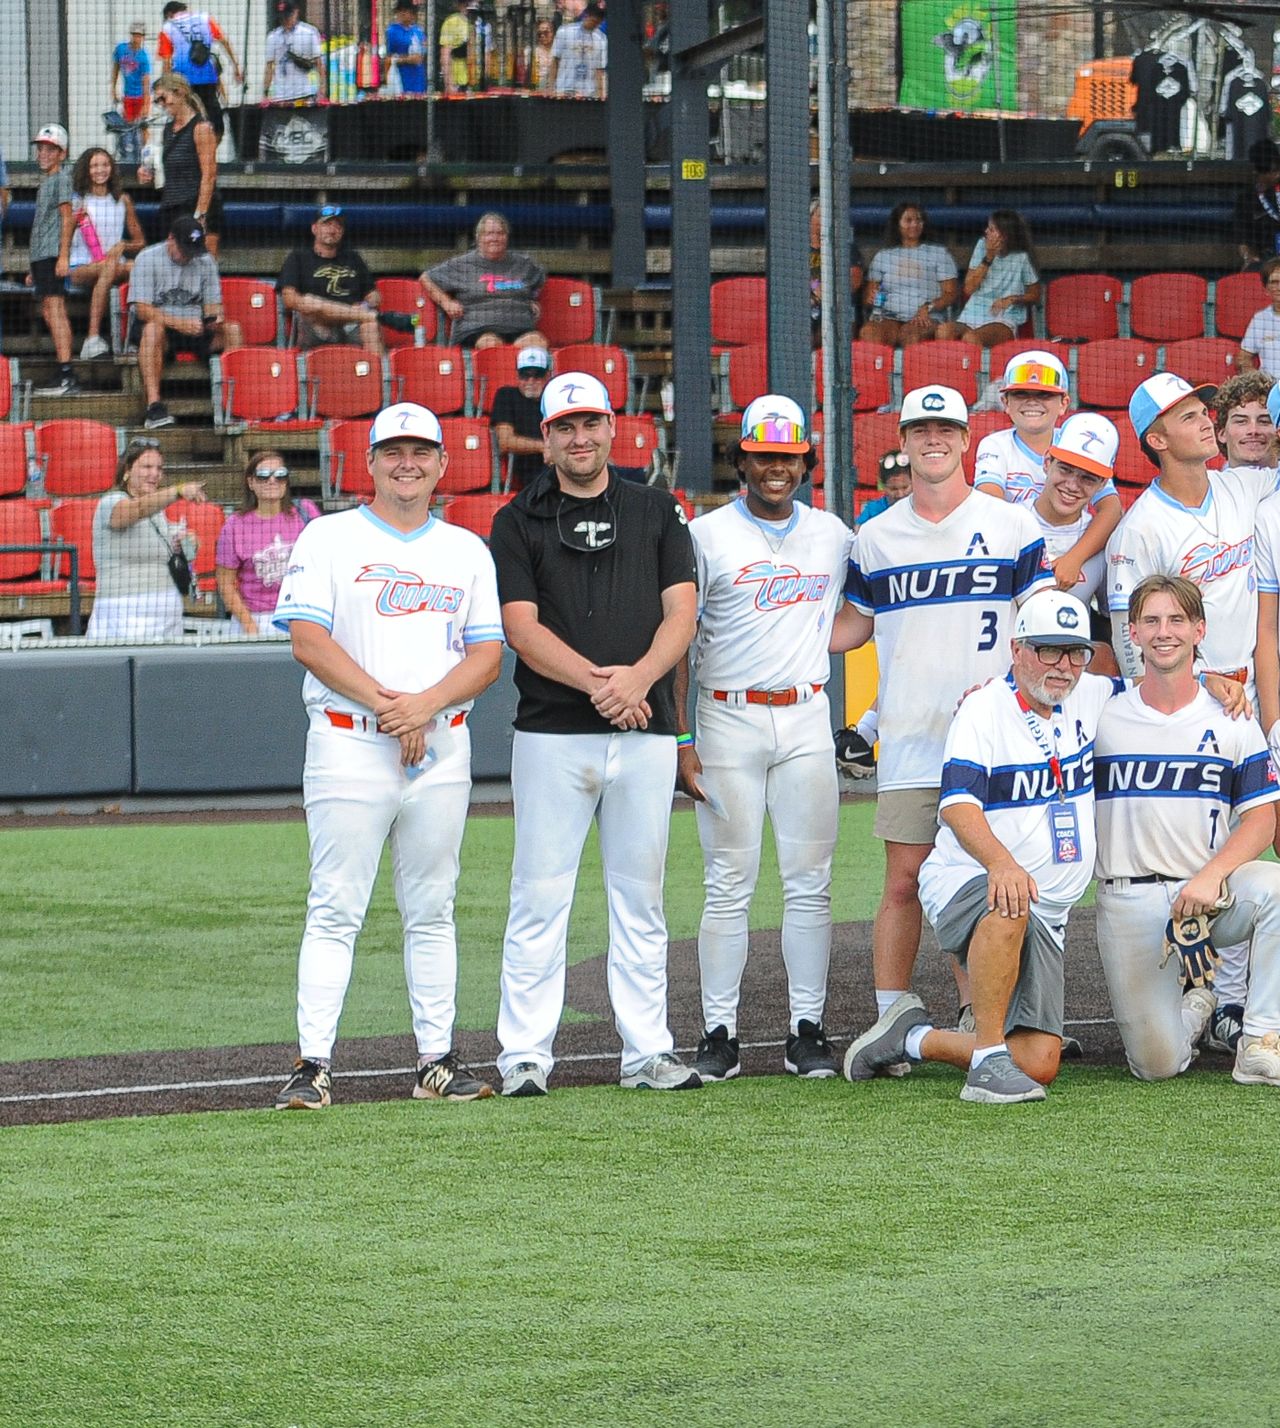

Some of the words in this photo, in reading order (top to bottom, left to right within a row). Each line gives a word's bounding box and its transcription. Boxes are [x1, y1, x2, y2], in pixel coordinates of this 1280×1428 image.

[355, 563, 465, 617] TROPICS
[888, 564, 999, 605] NUTS
[977, 611, 998, 652] 3
[1107, 761, 1225, 793] NUTS
[1209, 809, 1220, 851] 1
